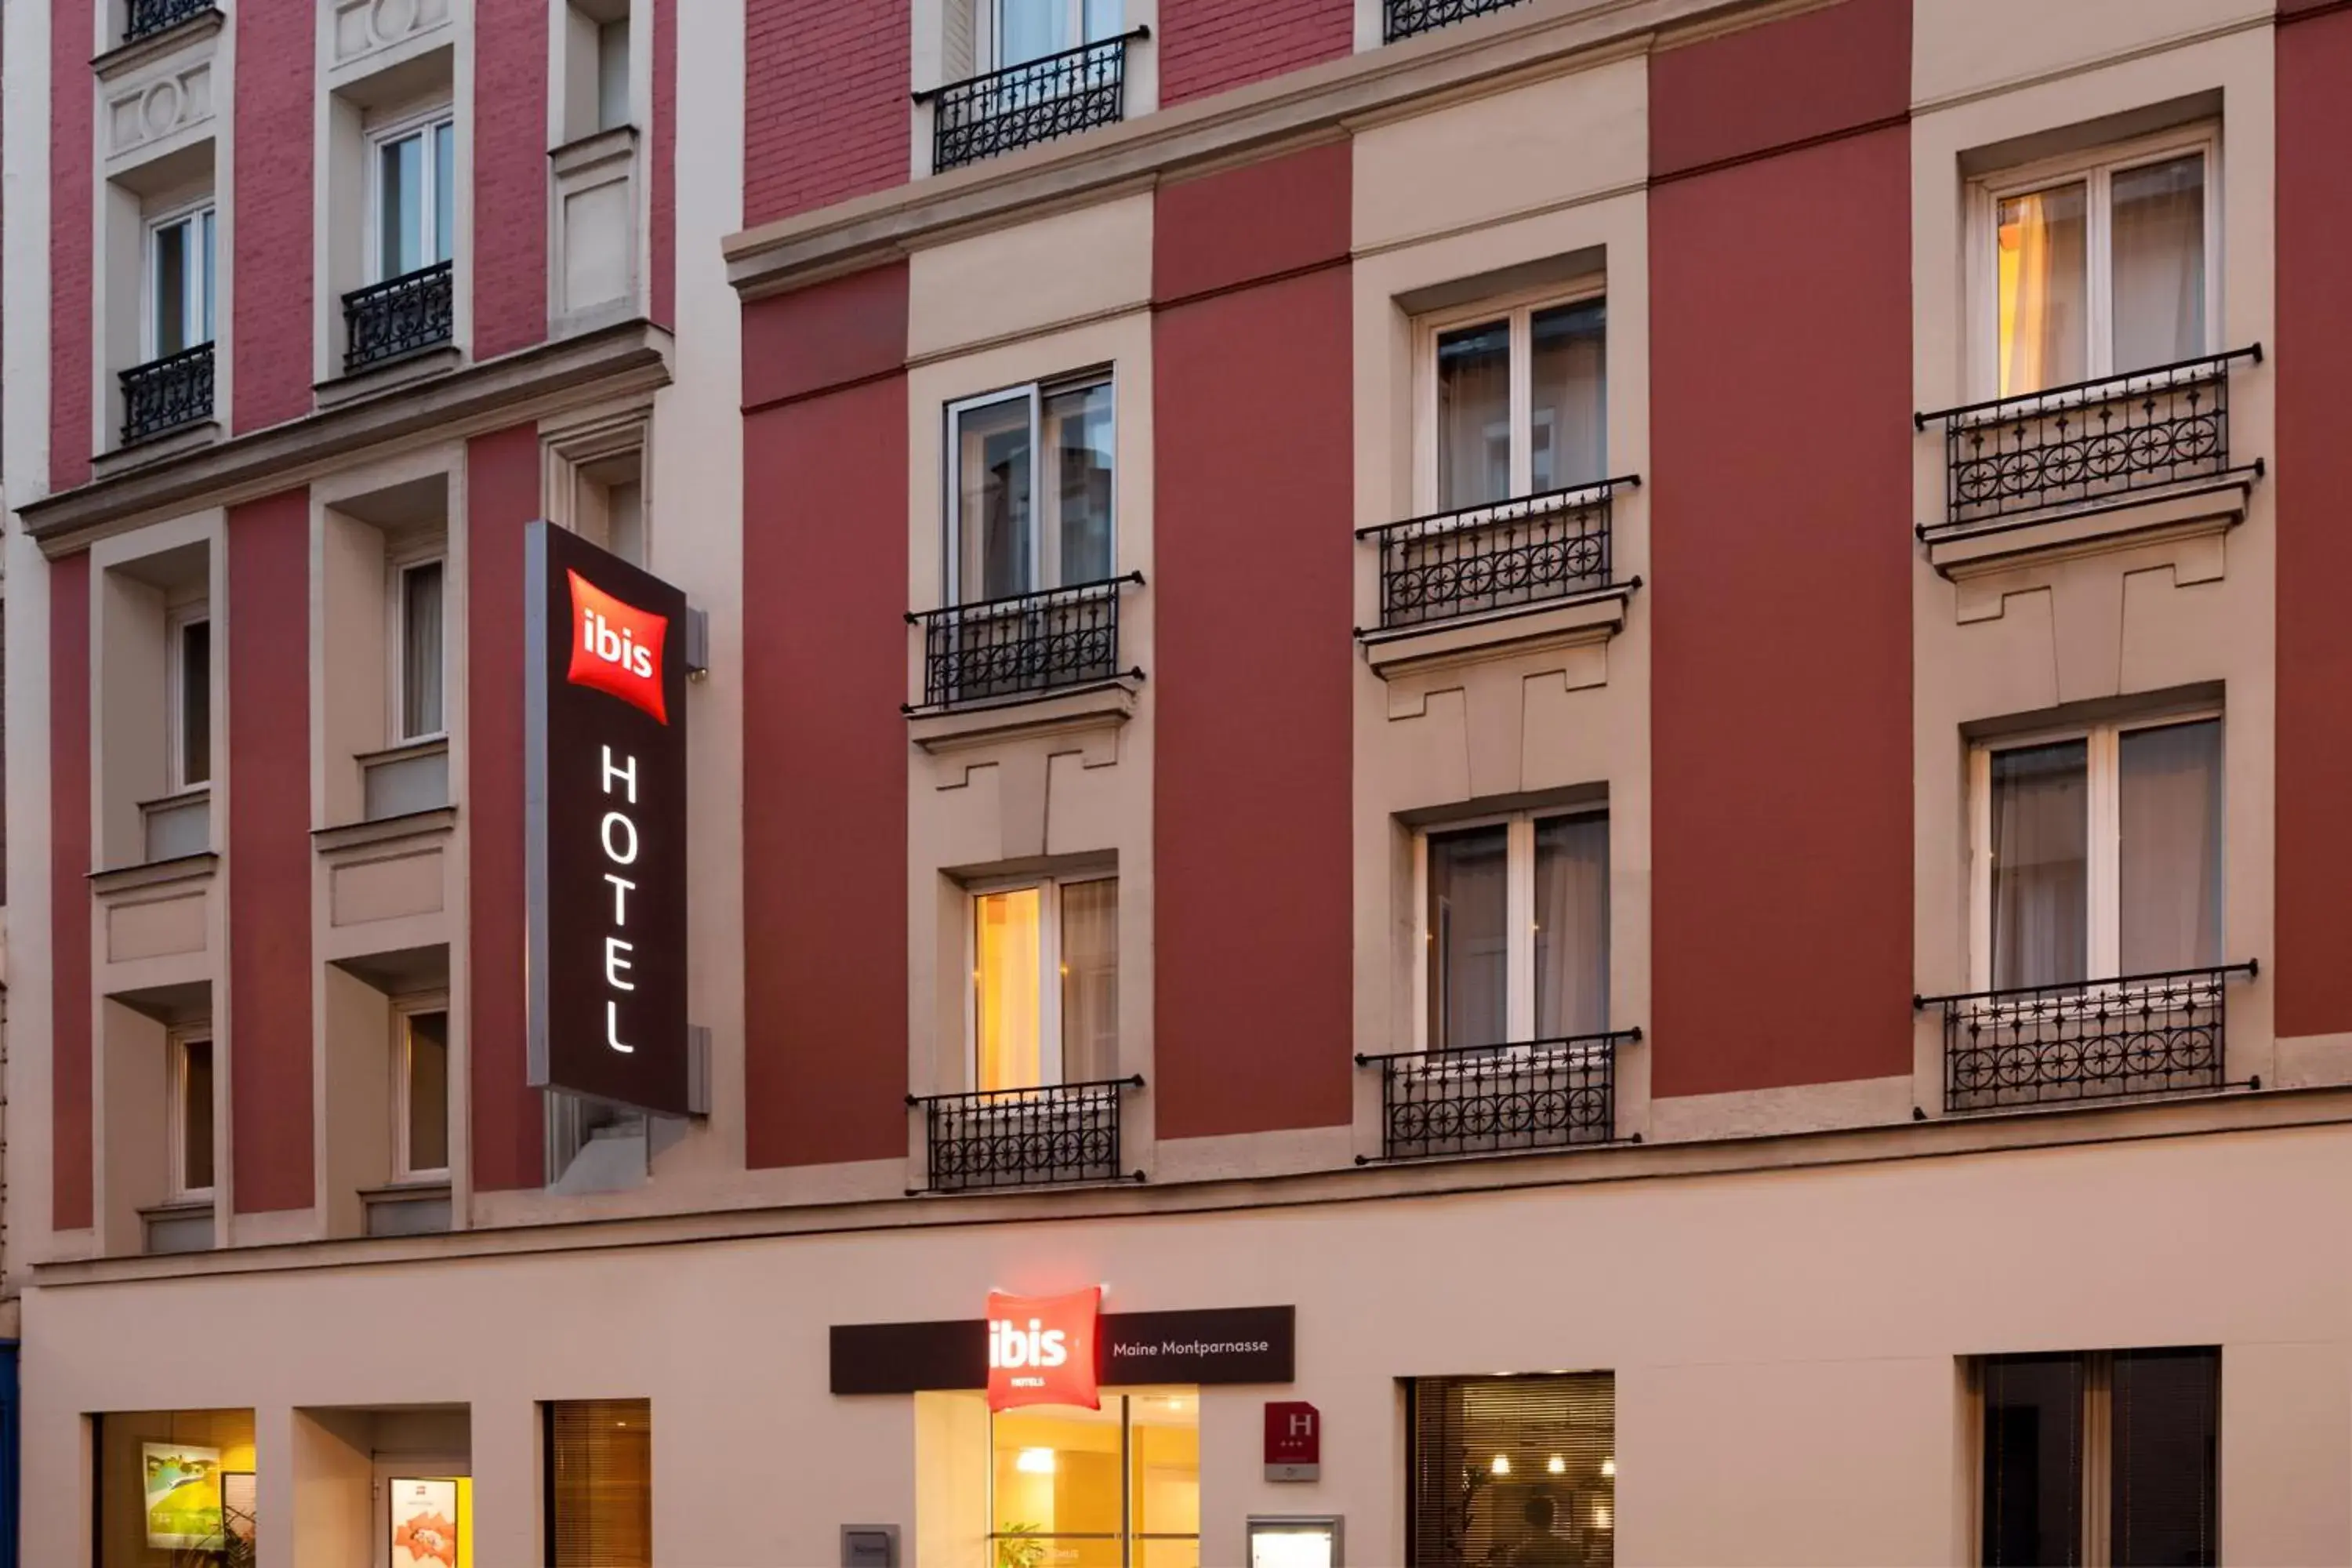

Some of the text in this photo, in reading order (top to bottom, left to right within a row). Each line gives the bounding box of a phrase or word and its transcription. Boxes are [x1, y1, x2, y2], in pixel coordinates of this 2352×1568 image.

[584, 608, 652, 678] ibis
[601, 744, 639, 1053] HOTEL
[989, 1319, 1067, 1367] ibis
[1113, 1340, 1269, 1357] Maine Montparnasse
[1290, 1414, 1312, 1436] H
